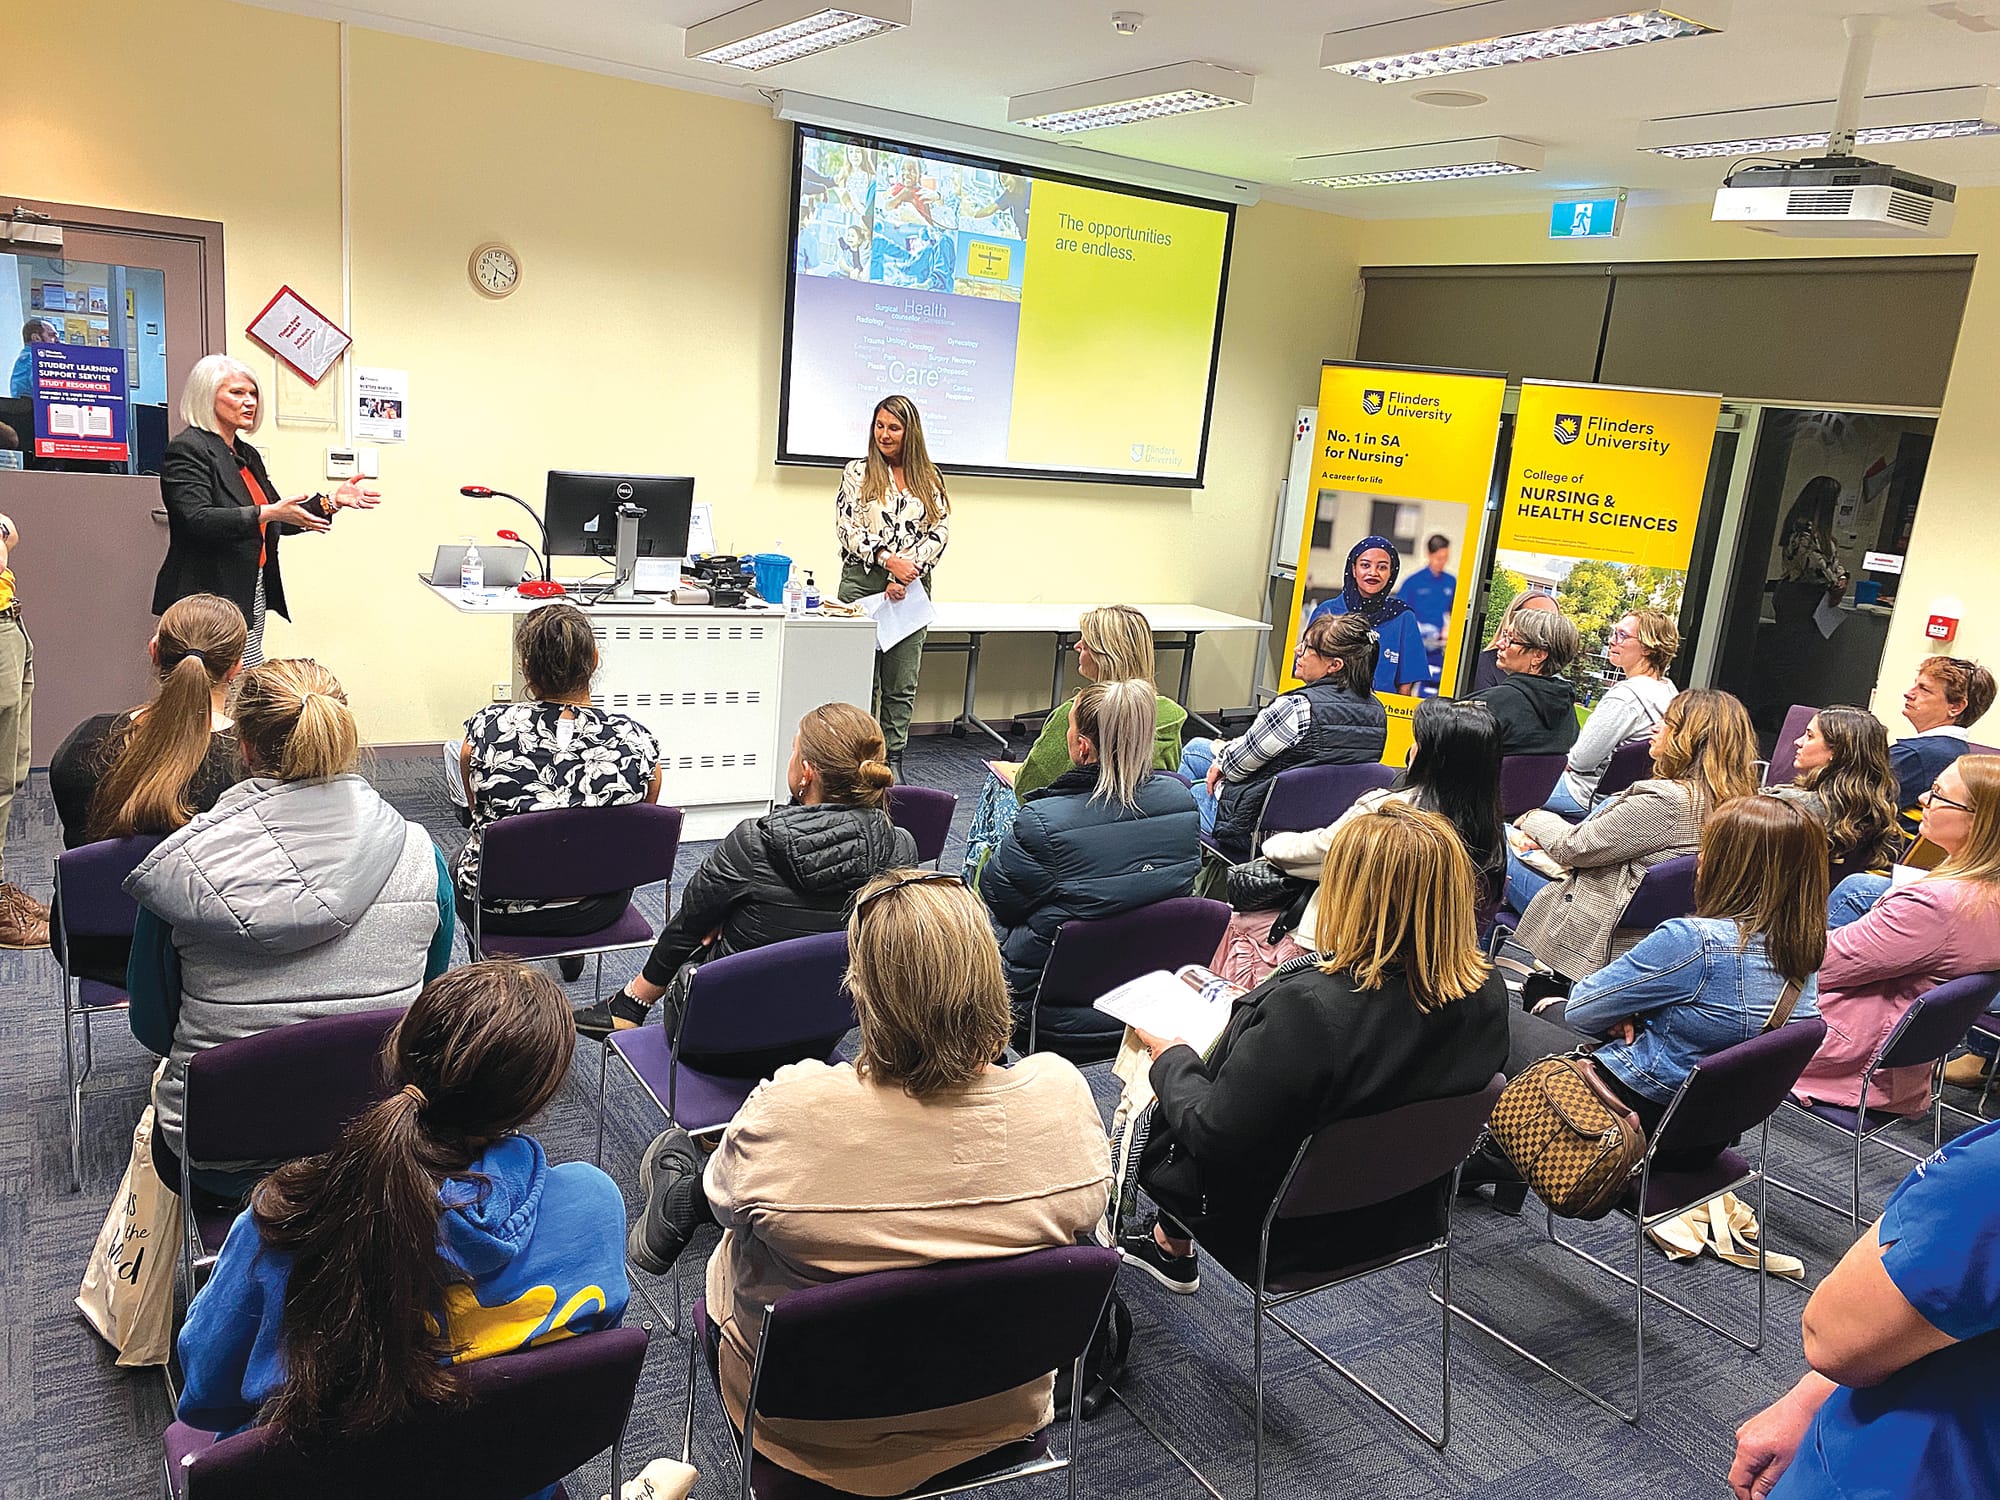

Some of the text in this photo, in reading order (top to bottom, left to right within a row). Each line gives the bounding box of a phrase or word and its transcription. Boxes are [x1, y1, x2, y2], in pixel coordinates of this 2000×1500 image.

[1058, 213, 1172, 246] The opportunities
[1056, 238, 1136, 261] are endless.
[875, 304, 898, 313] Surgical
[904, 299, 947, 318] Health
[856, 316, 884, 327] Radiology
[864, 336, 885, 345] Trauma
[886, 336, 908, 346] Urology
[909, 342, 935, 352] Oncology
[928, 354, 950, 364] Surgery
[952, 356, 976, 366] Recovery
[38, 361, 118, 374] STUDENT LEARNING
[888, 360, 939, 387] Care
[39, 370, 110, 381] SUPPORT SERVICE
[66, 382, 107, 390] RESOURCES
[1389, 392, 1440, 406] Flinders
[1387, 404, 1452, 423] University
[1588, 416, 1654, 435] Flinders
[1328, 430, 1400, 447] No. 1 in SA
[1586, 432, 1670, 456] University
[1146, 444, 1176, 454] Flinders
[1325, 446, 1344, 458] for
[1146, 455, 1182, 466] University
[1356, 474, 1368, 482] for
[1370, 476, 1383, 484] life
[1524, 468, 1584, 484] College of
[1520, 486, 1616, 508] NURSING &
[1518, 504, 1678, 532] HEALTH SCIENCES
[1384, 704, 1414, 716] /healt
[125, 1224, 151, 1242] the
